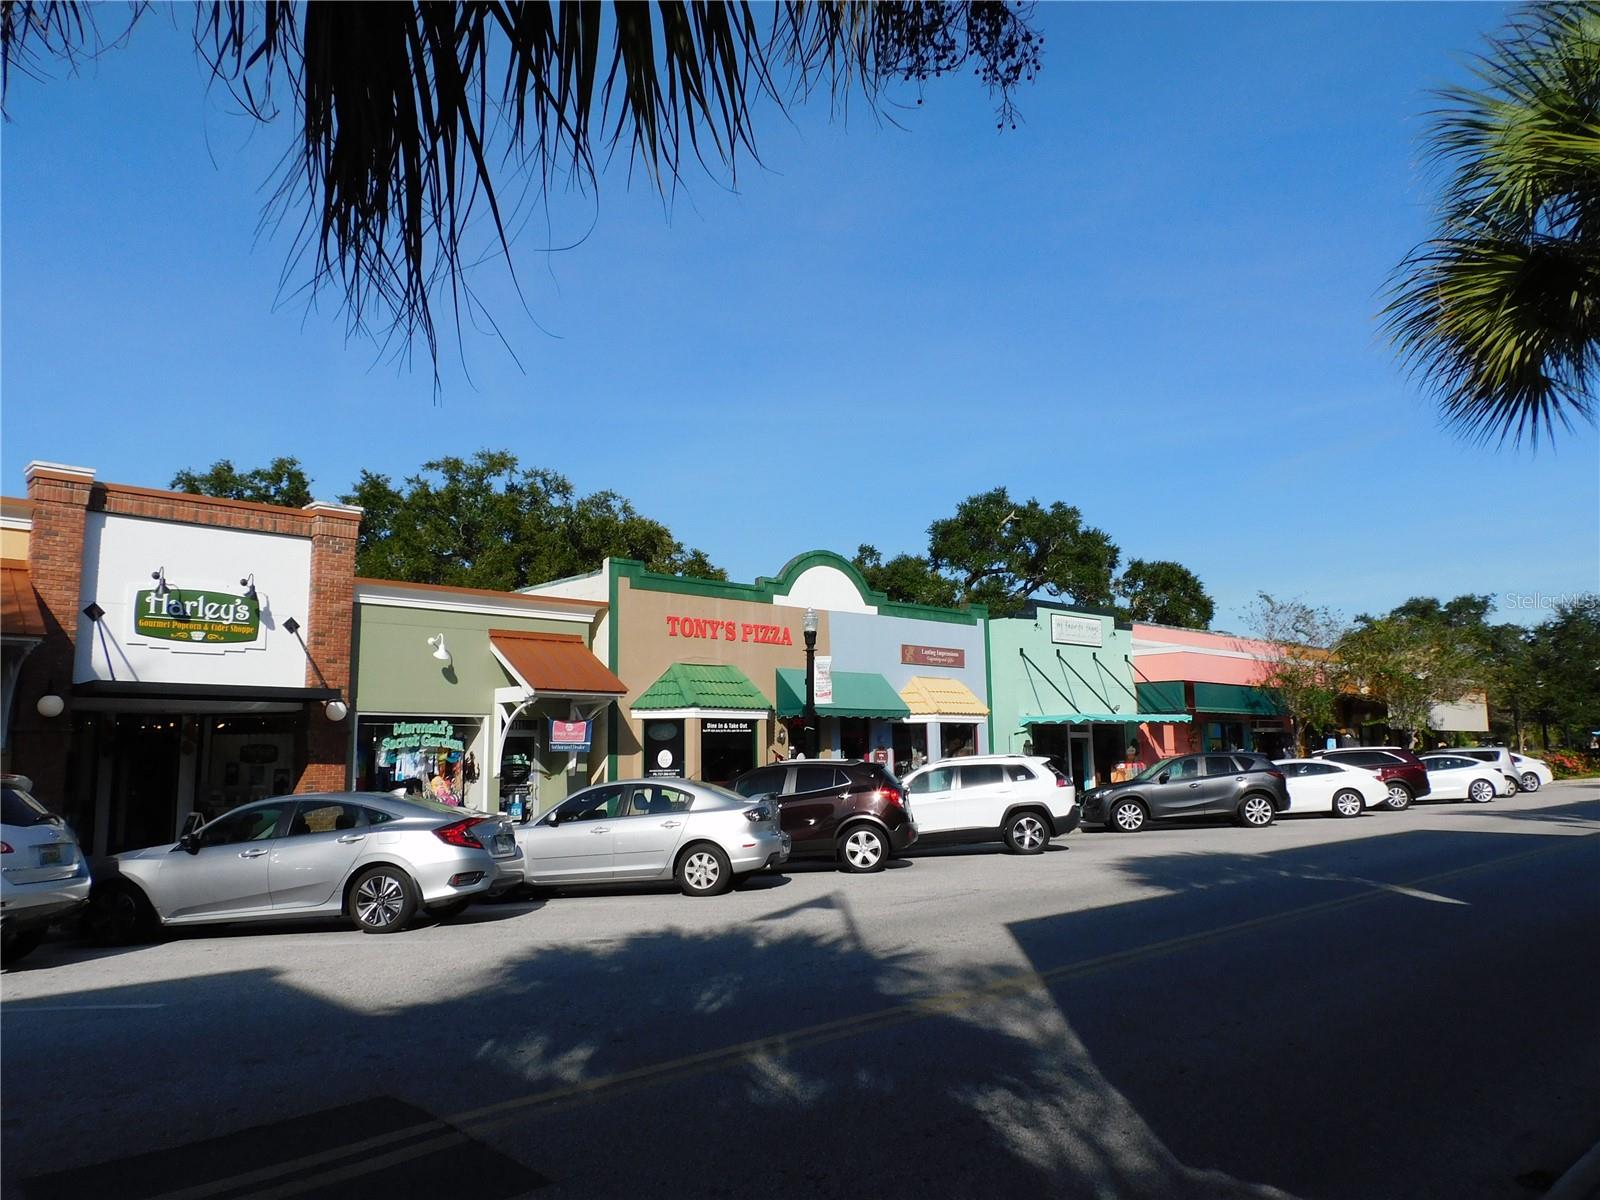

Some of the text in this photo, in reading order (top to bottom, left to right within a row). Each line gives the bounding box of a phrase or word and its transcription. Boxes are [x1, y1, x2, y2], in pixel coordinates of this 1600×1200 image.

[145, 592, 250, 625] Harley's
[138, 619, 171, 629] Gourmet
[172, 621, 202, 632] Popcorn
[211, 624, 229, 633] Cider
[230, 625, 255, 635] Shoppe
[666, 616, 793, 646] TONY'S PIZZA
[393, 719, 454, 736] Mermaid's
[381, 734, 465, 752] Secret Garden
